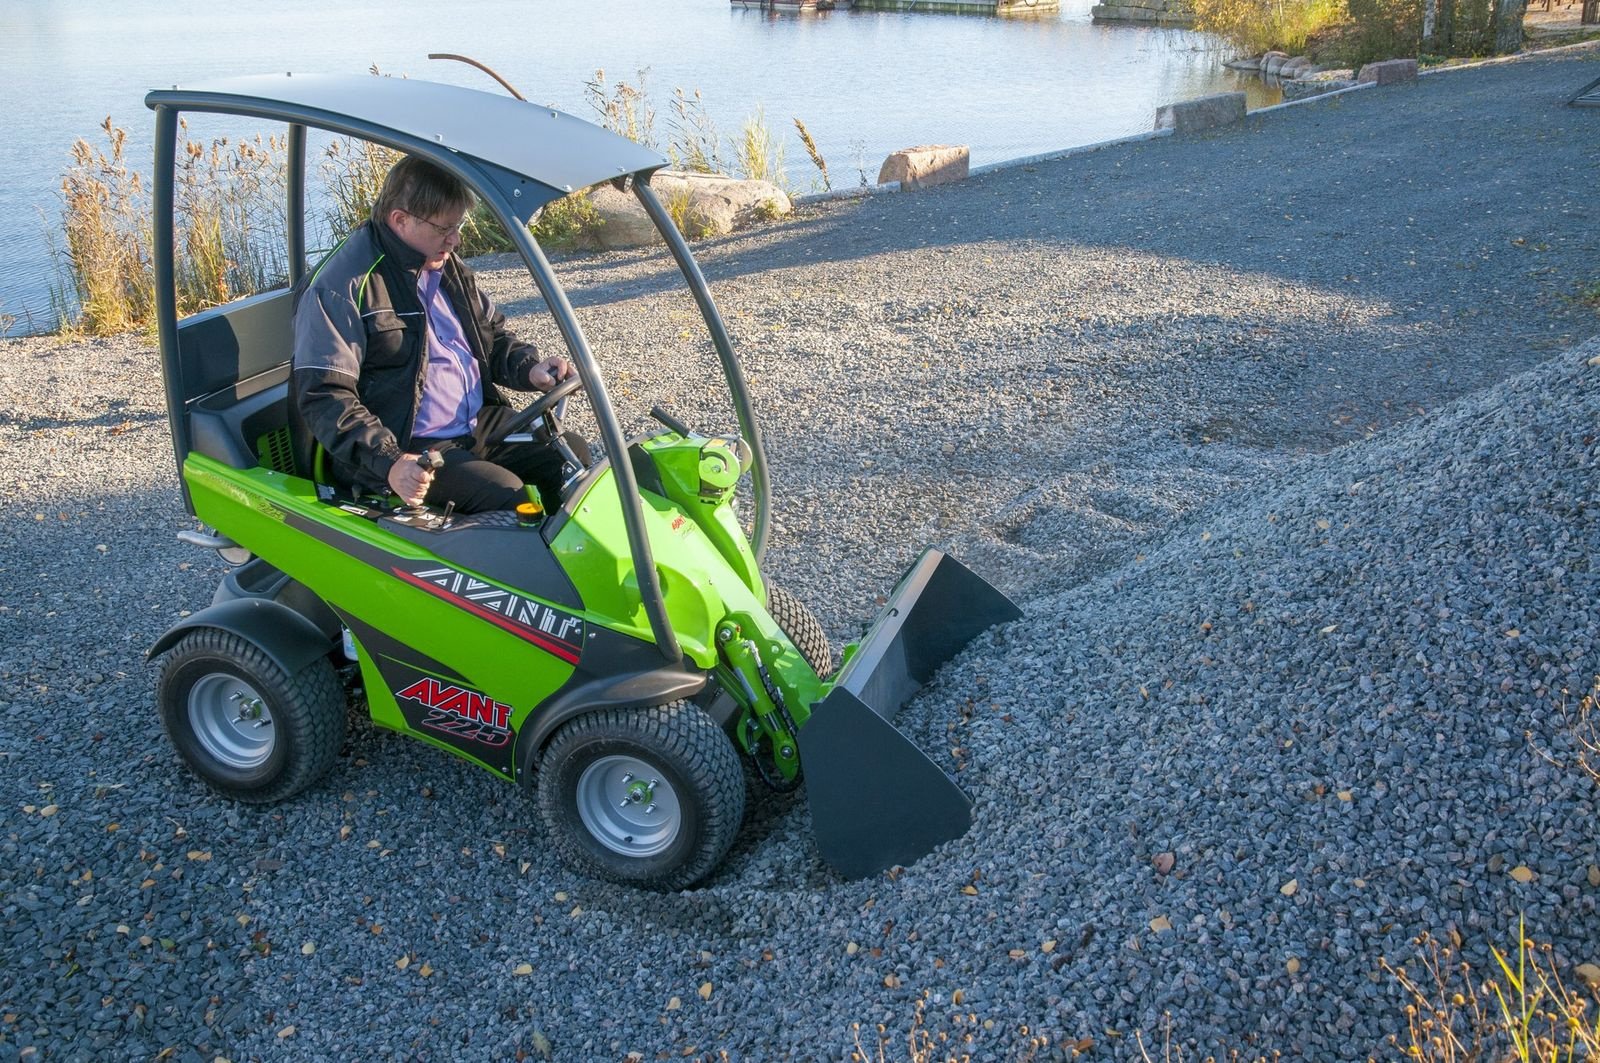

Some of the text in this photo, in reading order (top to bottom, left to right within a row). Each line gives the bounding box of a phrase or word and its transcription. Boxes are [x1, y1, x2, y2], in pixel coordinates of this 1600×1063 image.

[412, 568, 582, 639] AVANT
[395, 677, 514, 730] AVANT
[421, 710, 513, 746] 225
